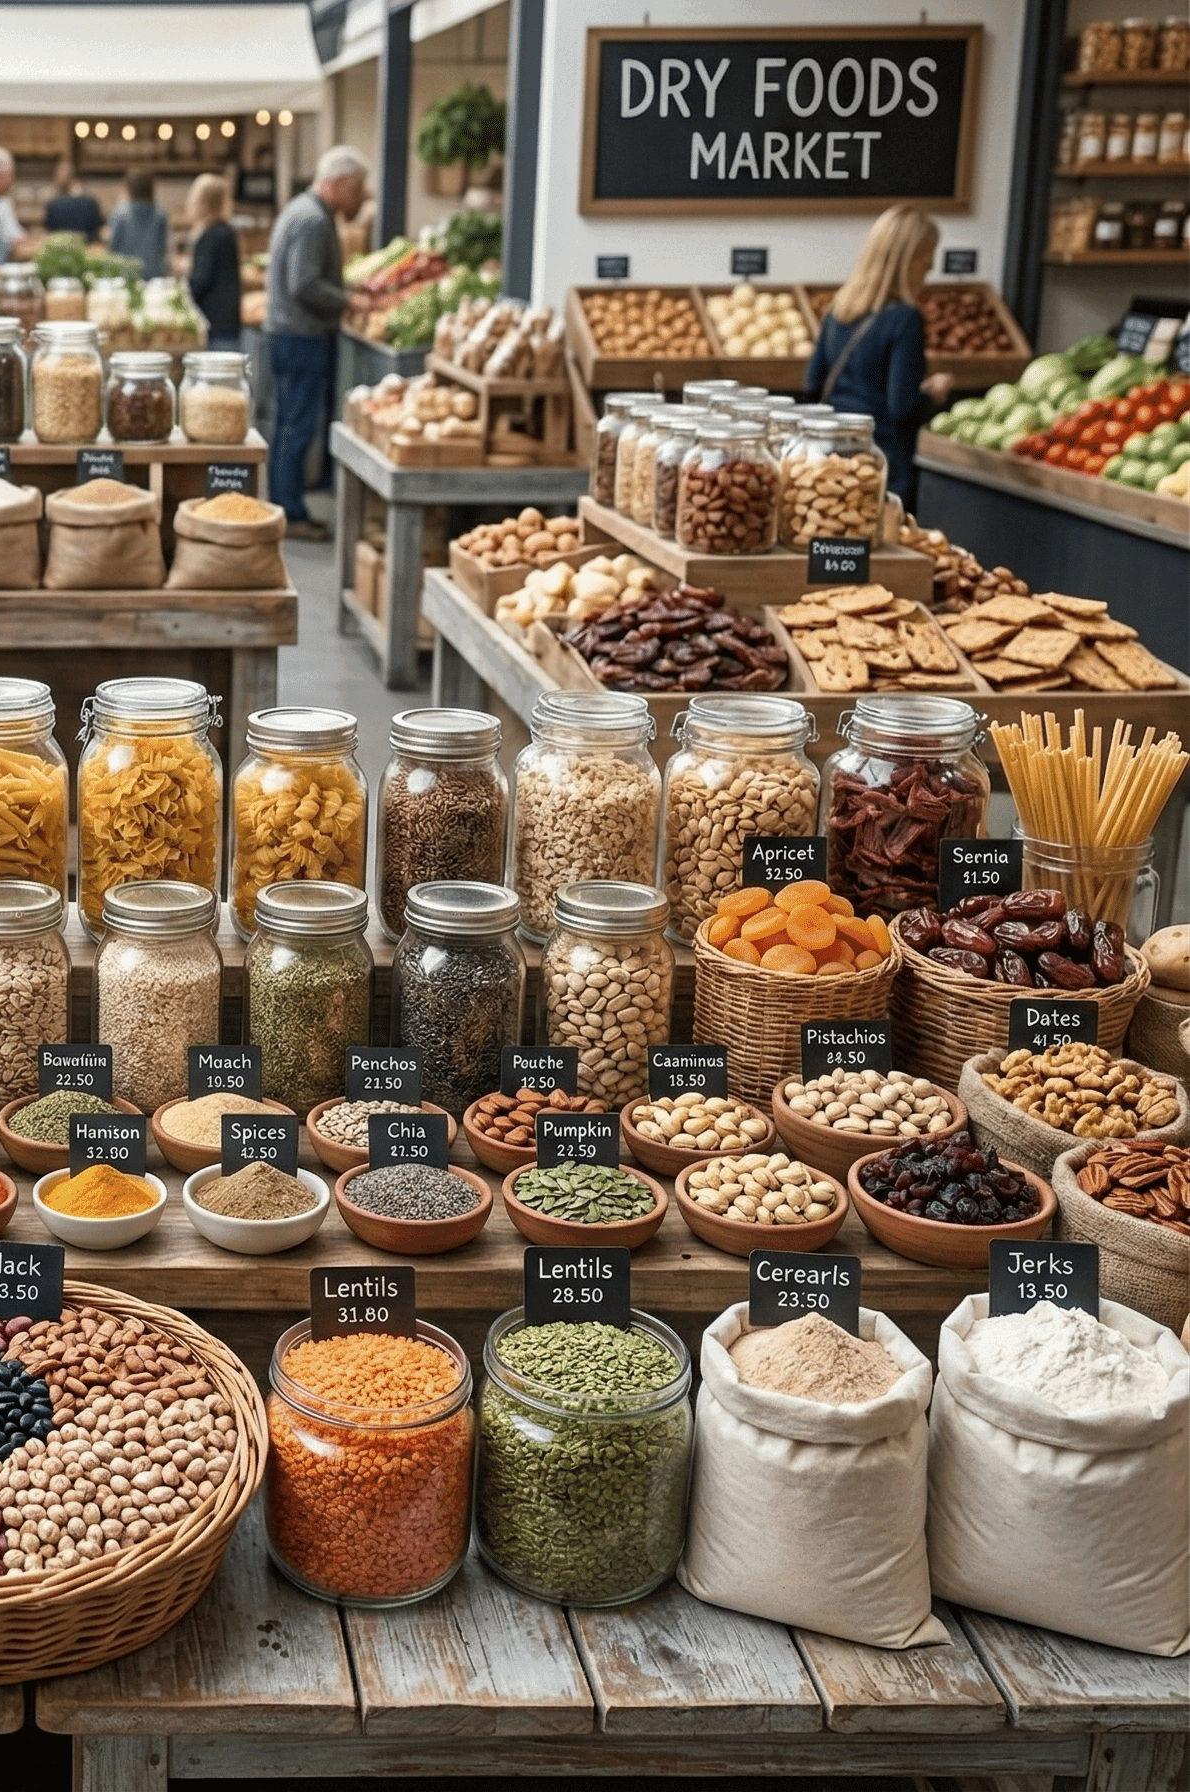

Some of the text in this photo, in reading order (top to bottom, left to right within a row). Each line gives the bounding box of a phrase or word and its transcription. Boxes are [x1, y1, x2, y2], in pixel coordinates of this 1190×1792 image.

[621, 58, 937, 117] DRY FOODS
[691, 132, 881, 179] MARKET
[766, 868, 802, 880] 32.50
[1027, 1008, 1080, 1026] Dates
[808, 1028, 885, 1044] Pistachios
[1033, 1034, 1072, 1046] 4150
[352, 1056, 416, 1071] Penchos
[56, 1074, 93, 1086] 22.50
[365, 1077, 402, 1089] 21.50
[521, 1077, 555, 1089] 1250
[670, 1074, 705, 1086] 18.50
[231, 1123, 286, 1144] Spices
[388, 1122, 426, 1138] Chia
[544, 1121, 611, 1142] Pumpkin
[540, 1257, 612, 1278] Lentils
[1008, 1252, 1073, 1274] Jerks
[325, 1276, 397, 1297] Lentils
[1018, 1283, 1067, 1299] 13.50
[553, 1288, 603, 1303] 28.50
